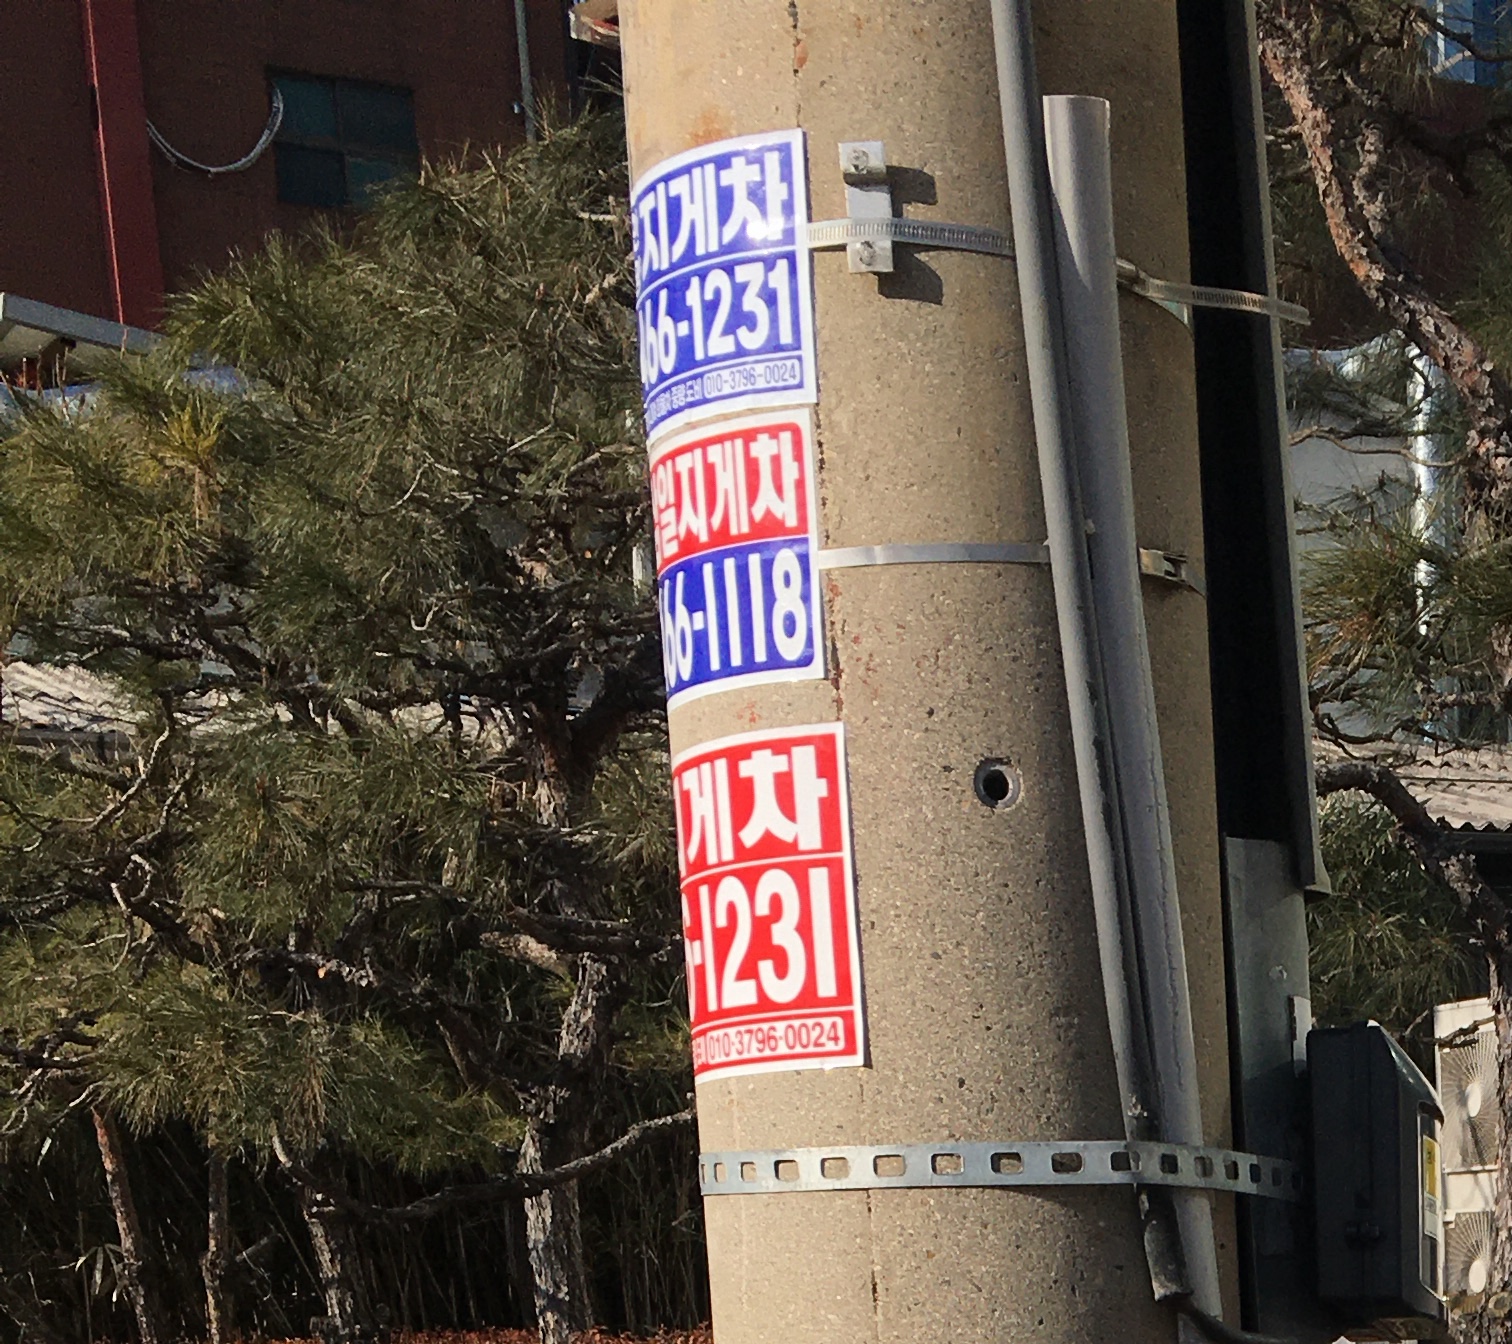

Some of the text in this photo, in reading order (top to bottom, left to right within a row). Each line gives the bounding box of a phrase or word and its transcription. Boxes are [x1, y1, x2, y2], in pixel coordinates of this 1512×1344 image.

[632, 151, 788, 294] 지게차
[705, 362, 797, 396] 010-3796-0024
[659, 548, 807, 690] 66-1118
[674, 745, 828, 877] 게차
